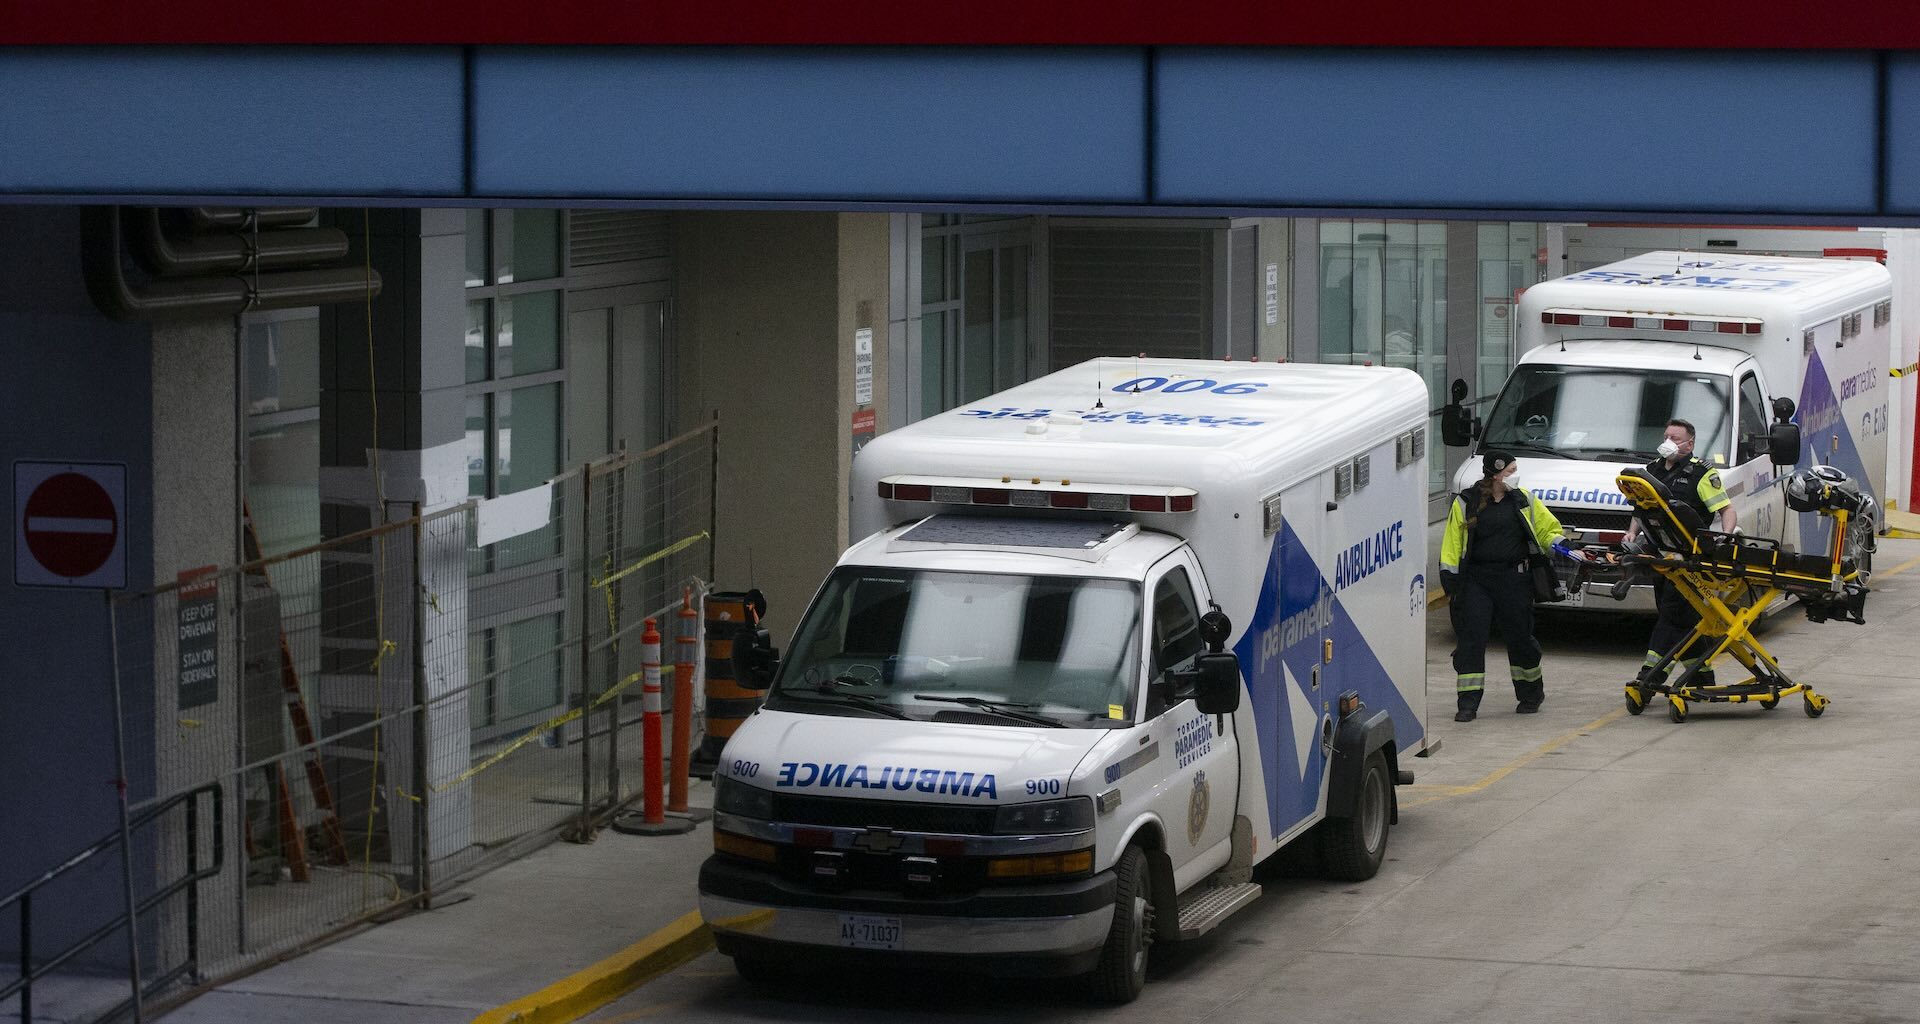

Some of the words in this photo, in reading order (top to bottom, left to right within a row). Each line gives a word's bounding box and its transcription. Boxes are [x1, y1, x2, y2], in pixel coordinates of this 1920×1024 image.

[1112, 377, 1269, 395] 900
[1335, 520, 1403, 594] AMBULANCE
[181, 606, 199, 622] KEEP
[201, 603, 215, 618] OFF
[180, 621, 217, 640] DRIVEWAY
[1261, 584, 1336, 674] paramedic
[183, 651, 200, 668] STAY
[201, 649, 215, 663] ON
[181, 664, 217, 685] SIDEWALK
[1177, 713, 1209, 738] TORONTO
[1175, 721, 1212, 759] PARAMEDIC
[1179, 742, 1211, 769] SERVICES
[733, 759, 760, 778] 900
[1025, 778, 1060, 795] 900
